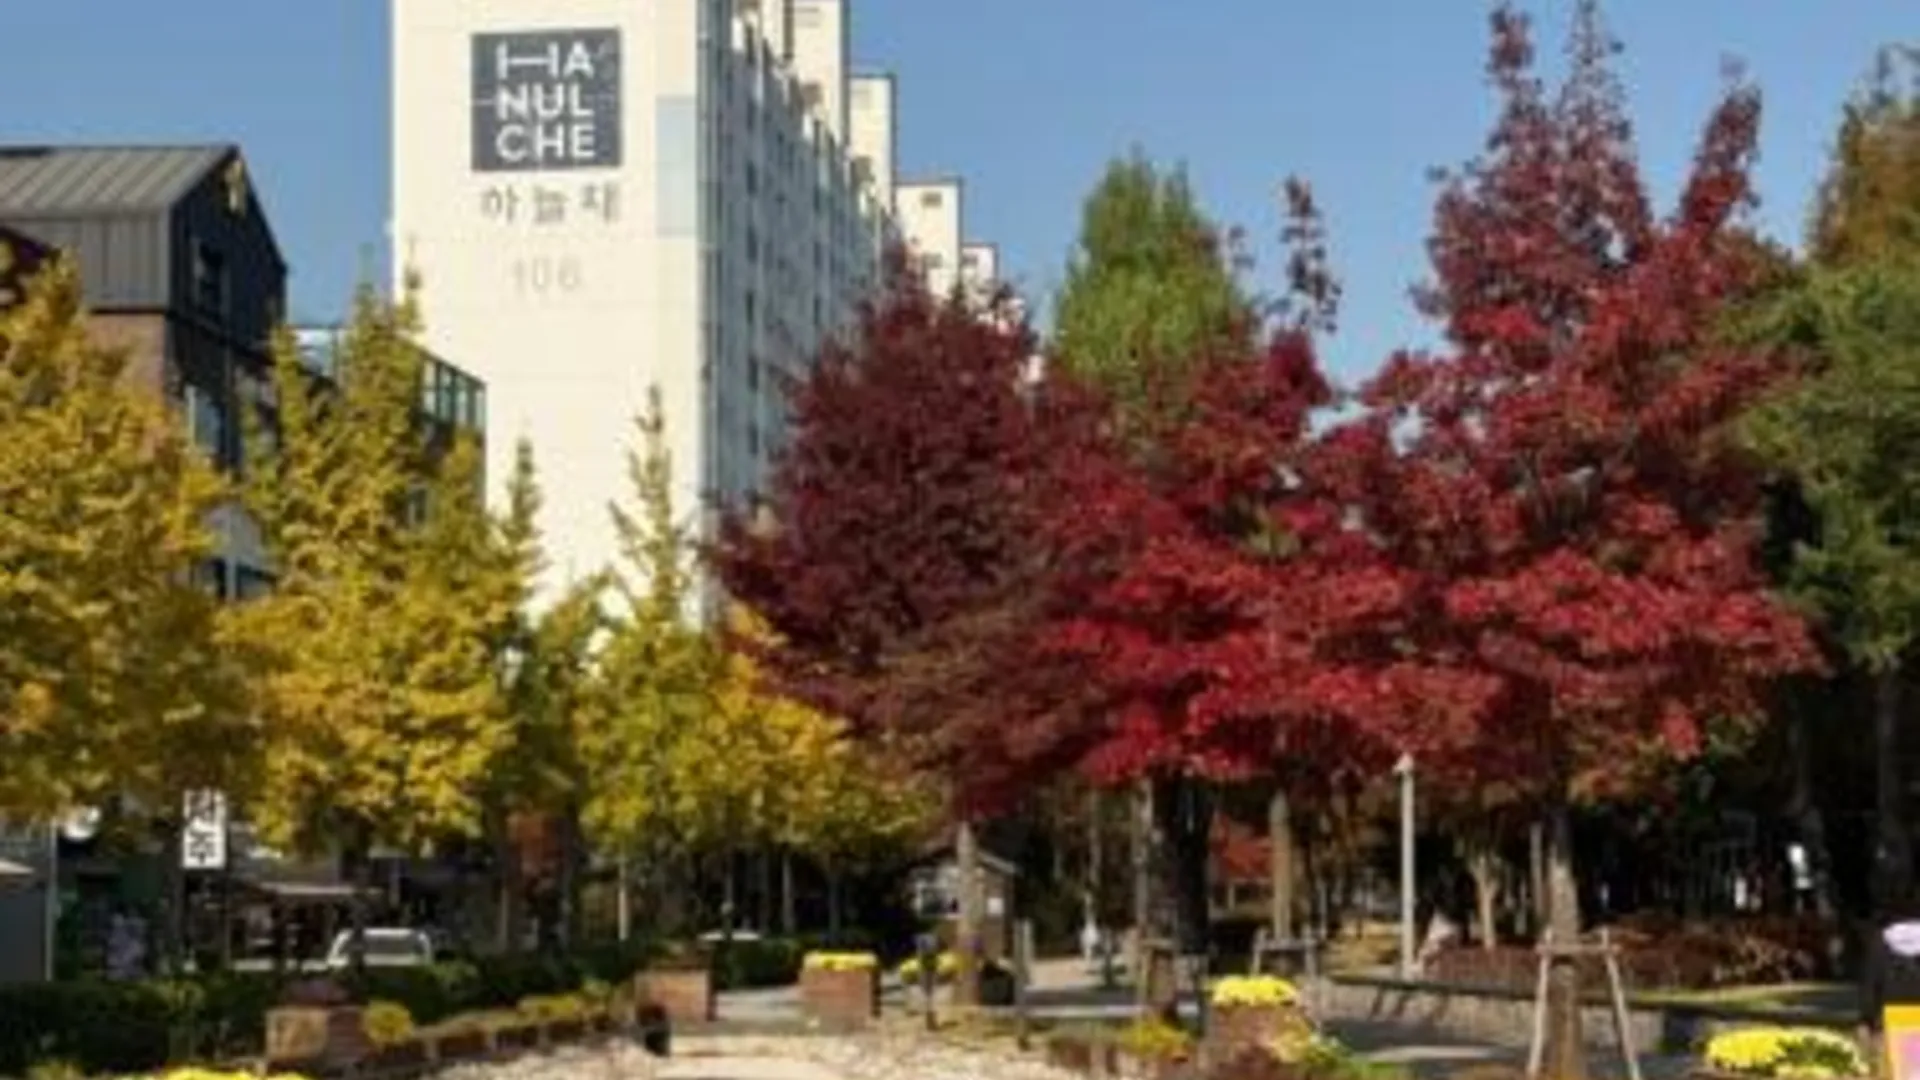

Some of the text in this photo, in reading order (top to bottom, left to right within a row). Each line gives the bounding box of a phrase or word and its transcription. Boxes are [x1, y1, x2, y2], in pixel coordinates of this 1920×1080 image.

[496, 40, 595, 80] HA
[497, 82, 595, 120] NUL
[495, 122, 597, 162] CHE
